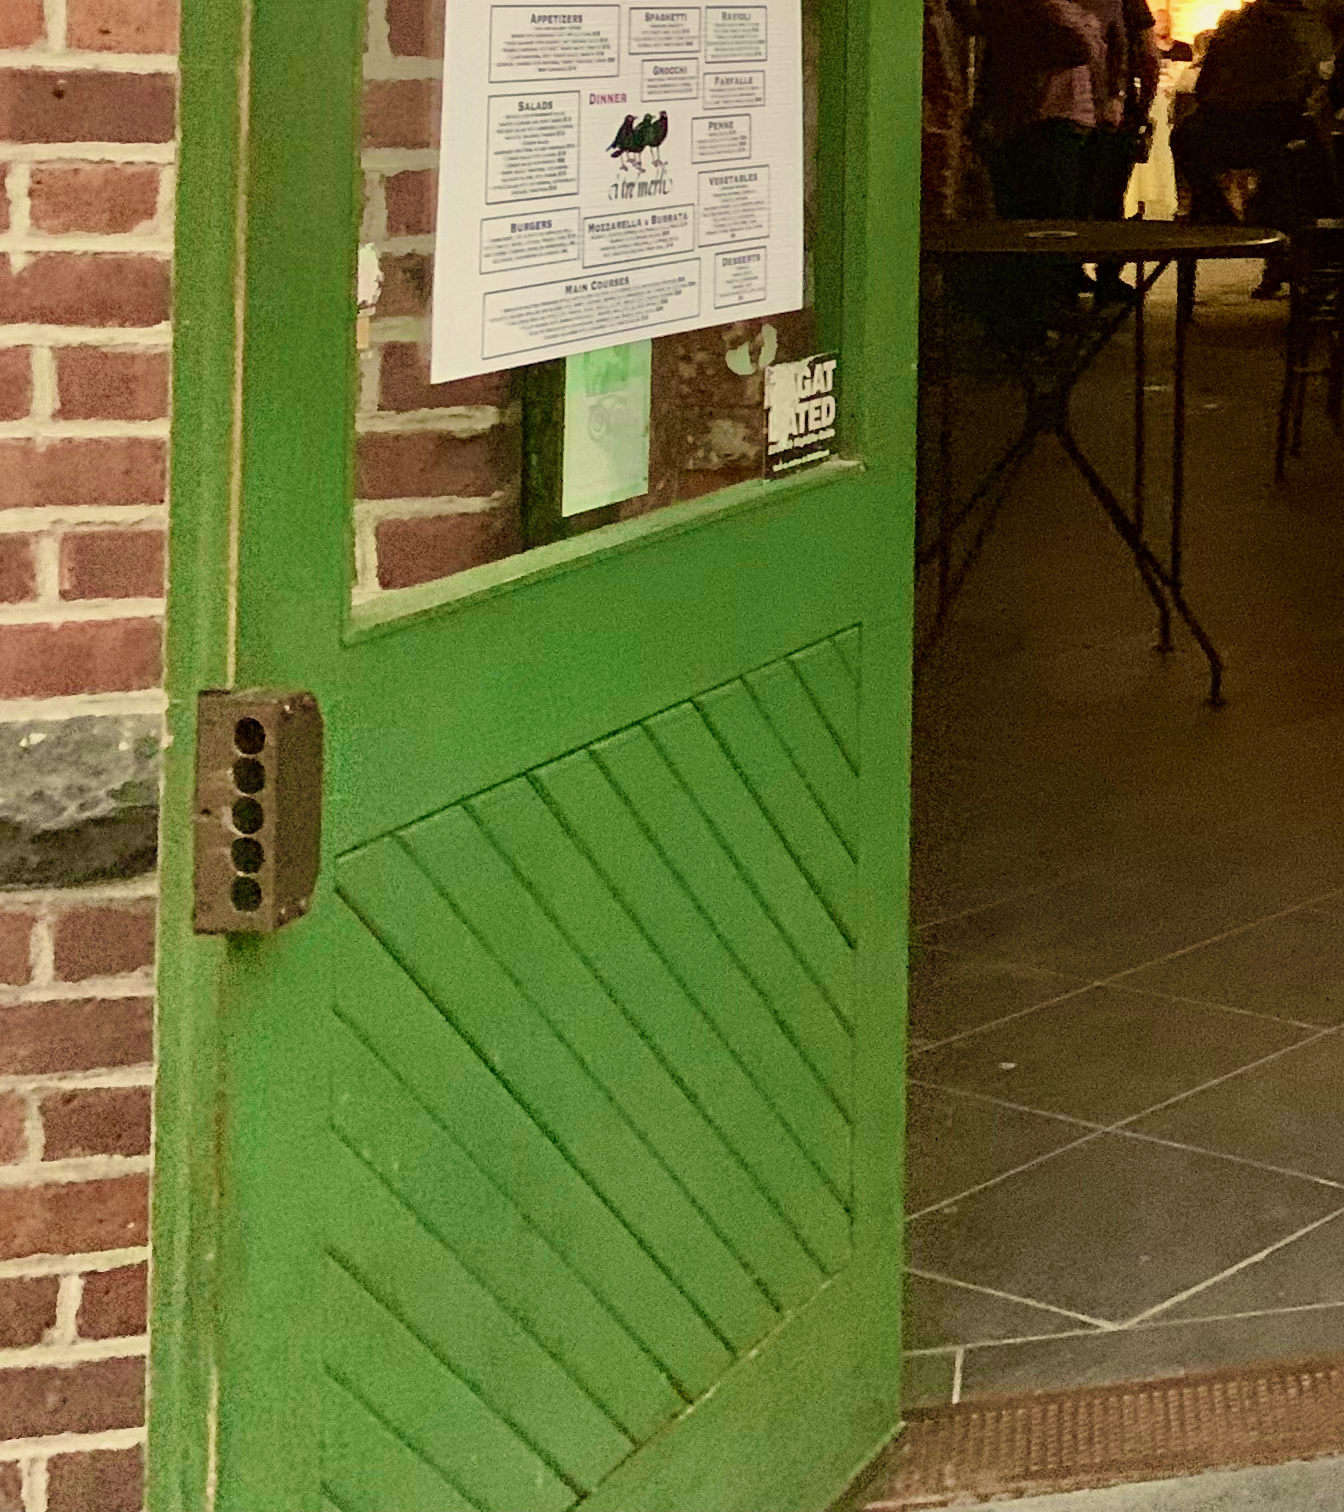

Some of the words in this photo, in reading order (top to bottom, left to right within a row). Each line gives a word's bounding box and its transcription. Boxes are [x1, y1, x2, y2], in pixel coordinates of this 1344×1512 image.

[530, 13, 583, 24] APPETIZERS
[644, 12, 688, 22] SPAGHETTI
[589, 93, 627, 105] DINNER
[517, 101, 553, 112] SALADS
[510, 220, 553, 234] BURGERS
[588, 218, 642, 233] MOZZARELLA
[651, 212, 689, 225] BURRATA
[565, 284, 588, 295] MAIN
[590, 277, 630, 291] COURSES
